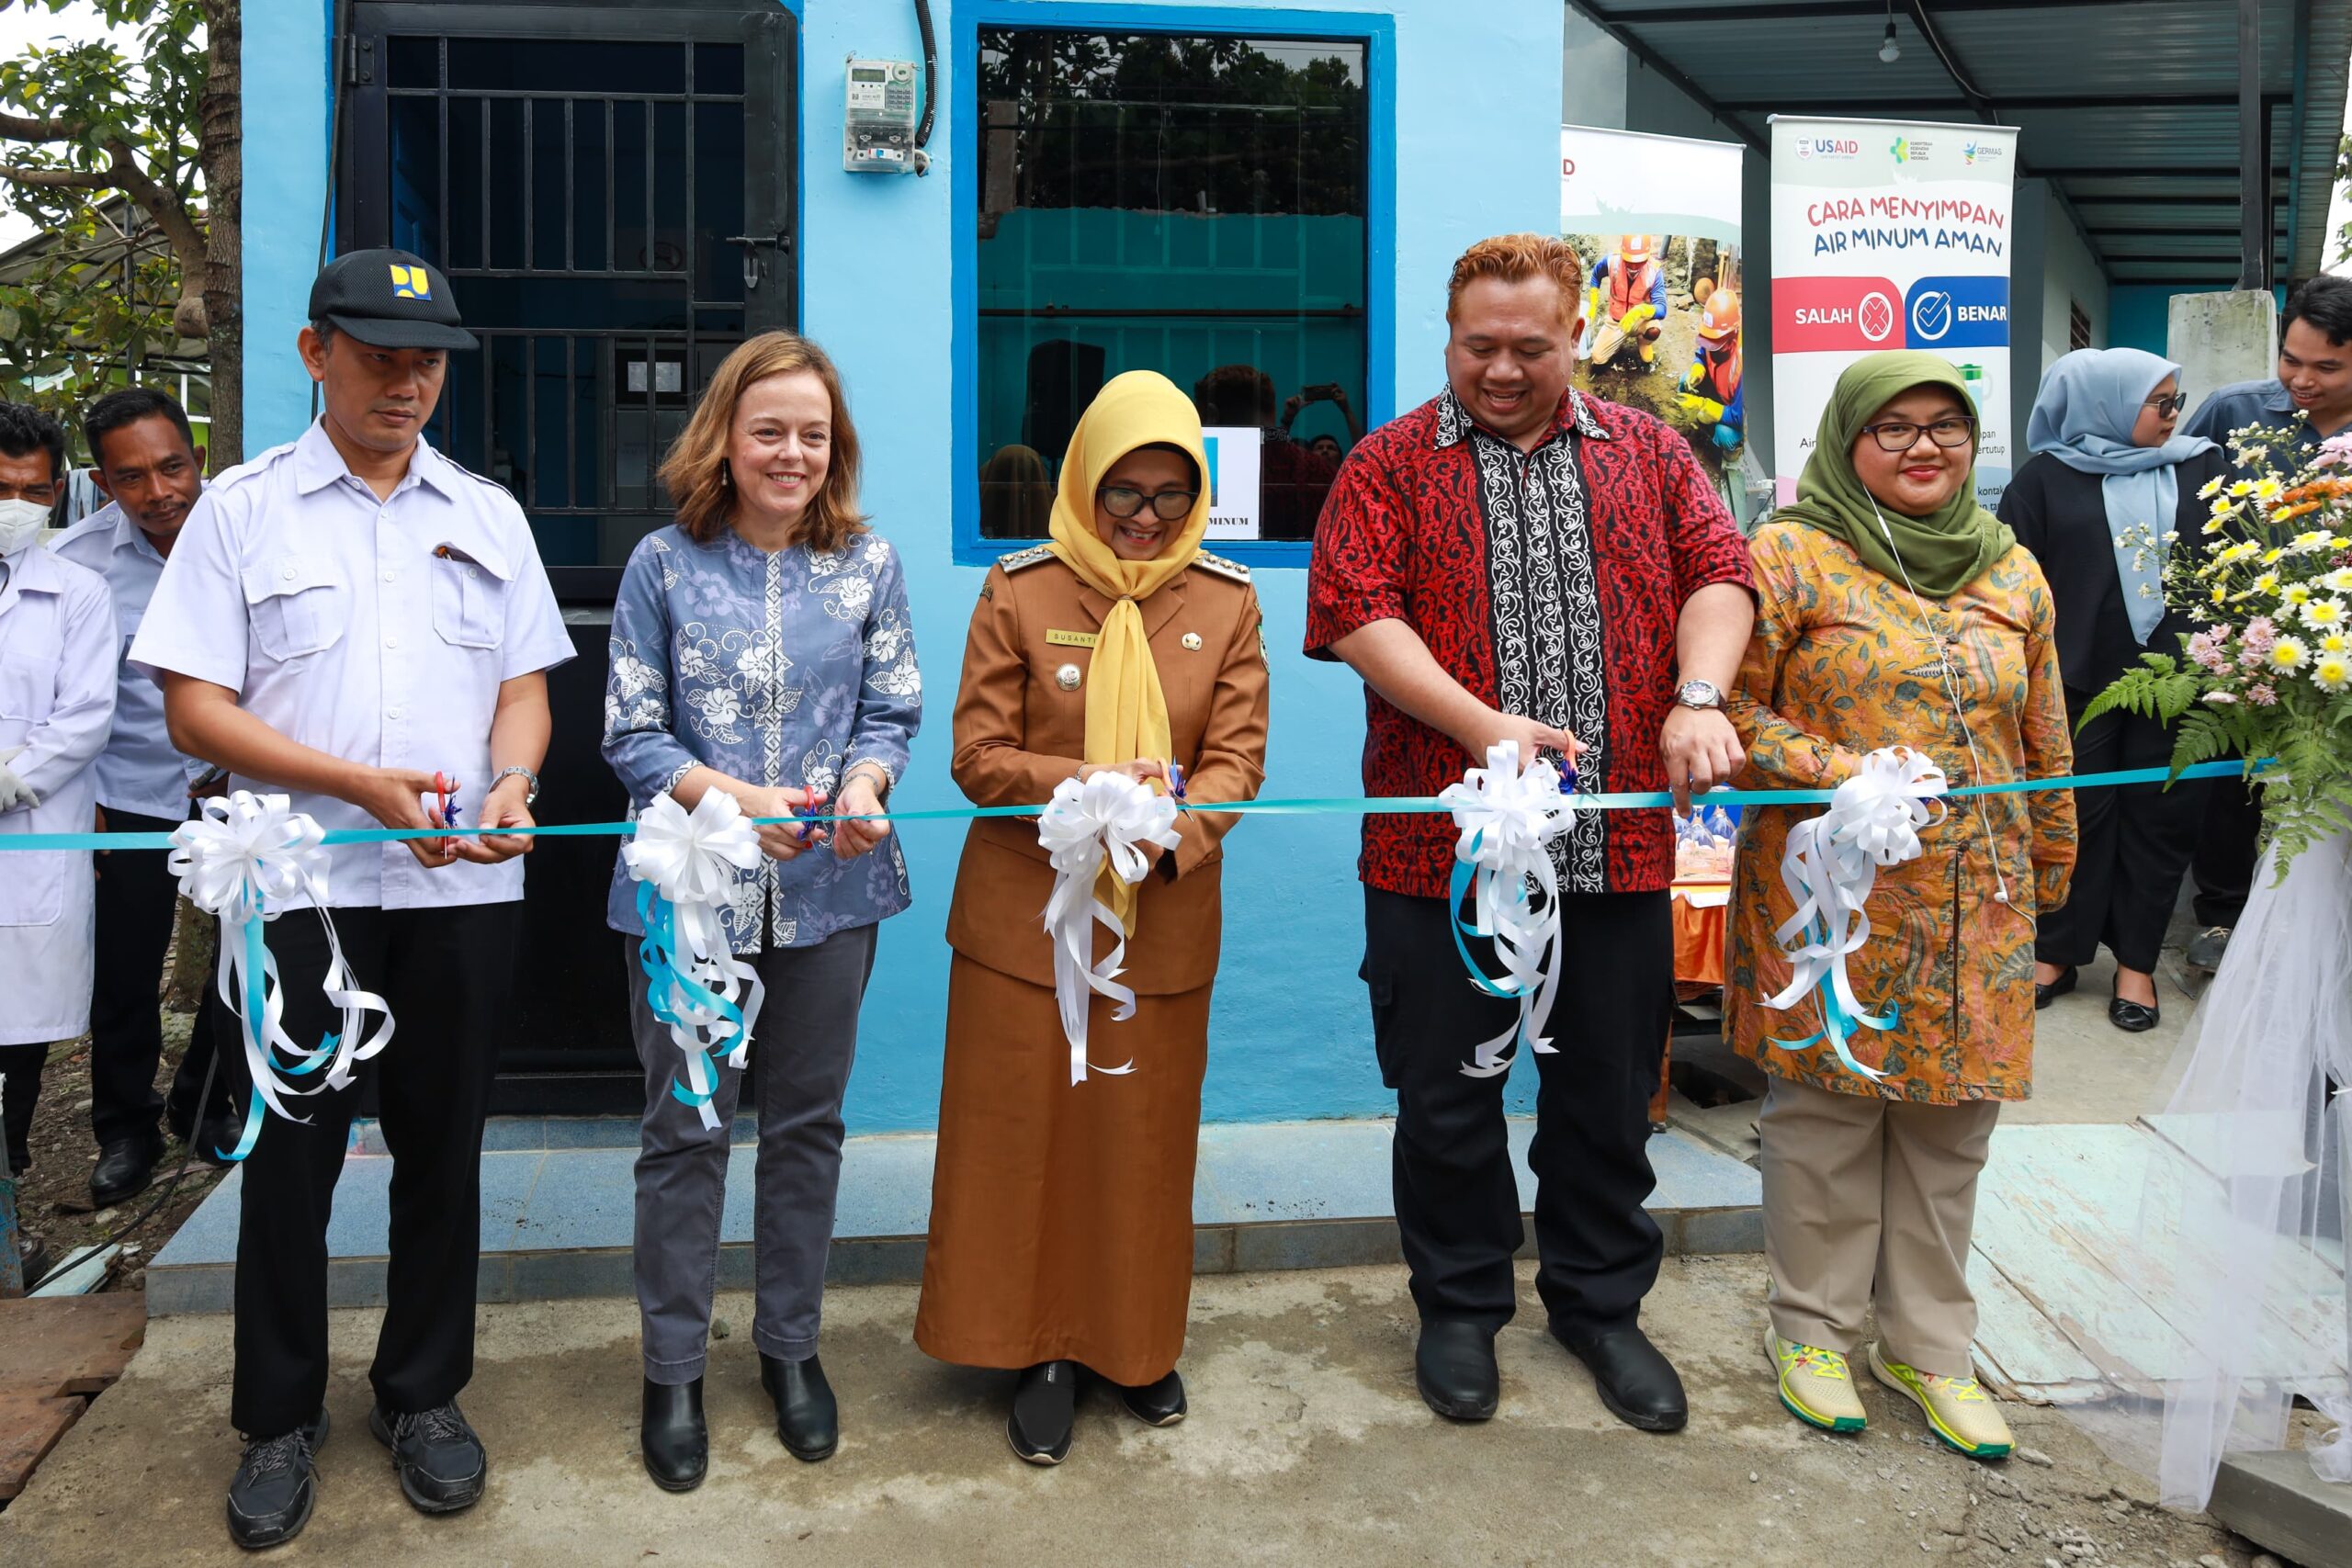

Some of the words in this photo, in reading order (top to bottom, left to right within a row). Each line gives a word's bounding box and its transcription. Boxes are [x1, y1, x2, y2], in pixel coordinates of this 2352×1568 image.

[1815, 140, 1859, 154] USAID
[1807, 197, 1865, 227] CARA
[1871, 197, 2004, 229] MENYIMPAN
[1815, 231, 1847, 256] AIR
[1851, 228, 1928, 249] MINUM
[1934, 229, 2002, 257] AMAN
[1794, 308, 1852, 324] SALAH
[1957, 306, 2007, 321] BENAR
[1980, 431, 1996, 441] pan
[1208, 517, 1249, 525] MINUM
